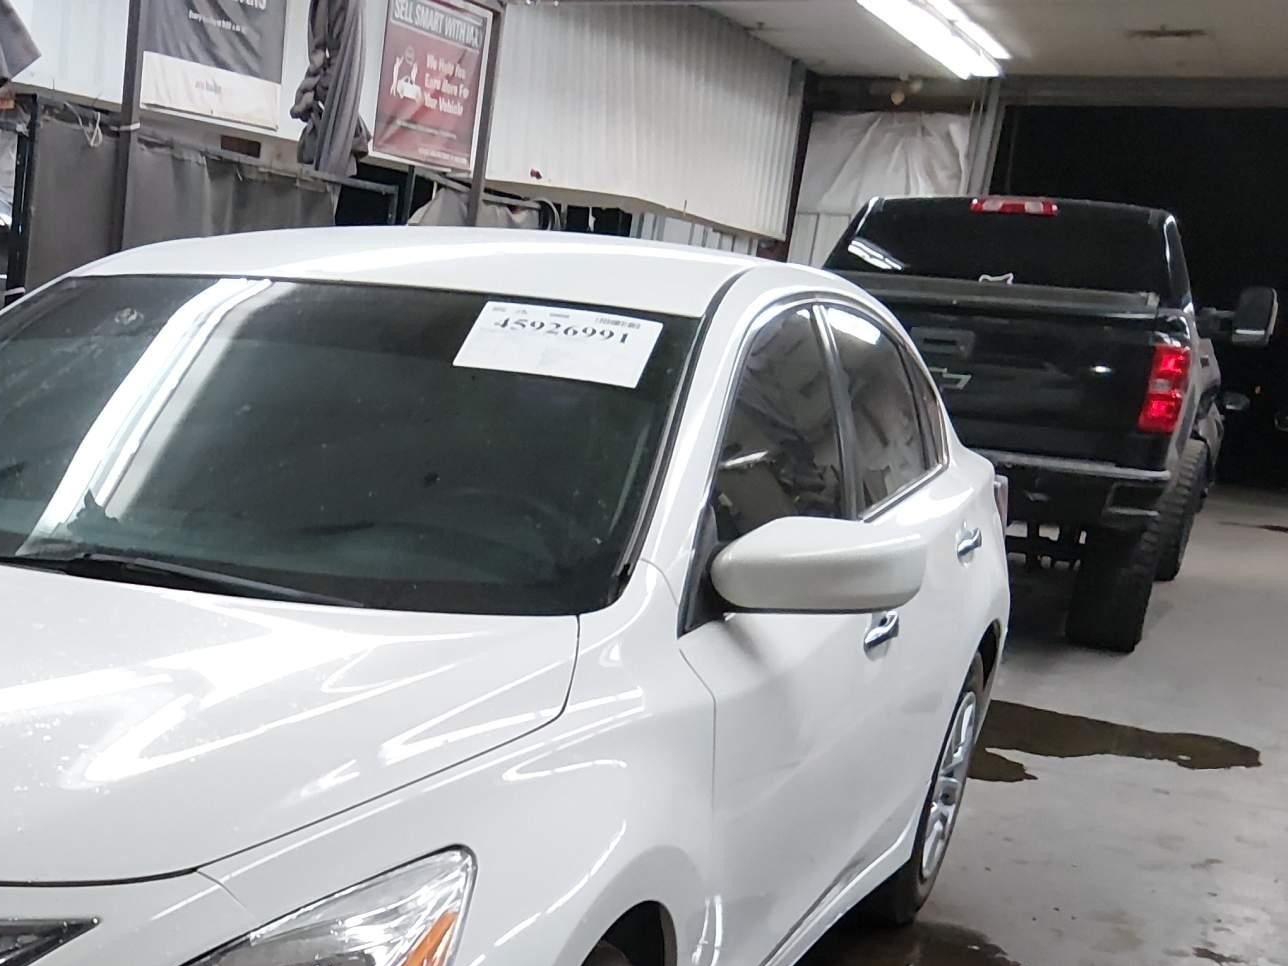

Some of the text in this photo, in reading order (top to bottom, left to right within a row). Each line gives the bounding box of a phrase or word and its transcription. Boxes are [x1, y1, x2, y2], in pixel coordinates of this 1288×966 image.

[394, 0, 414, 24] SELL
[414, 4, 445, 34] SMART
[494, 317, 629, 344] 45926991
